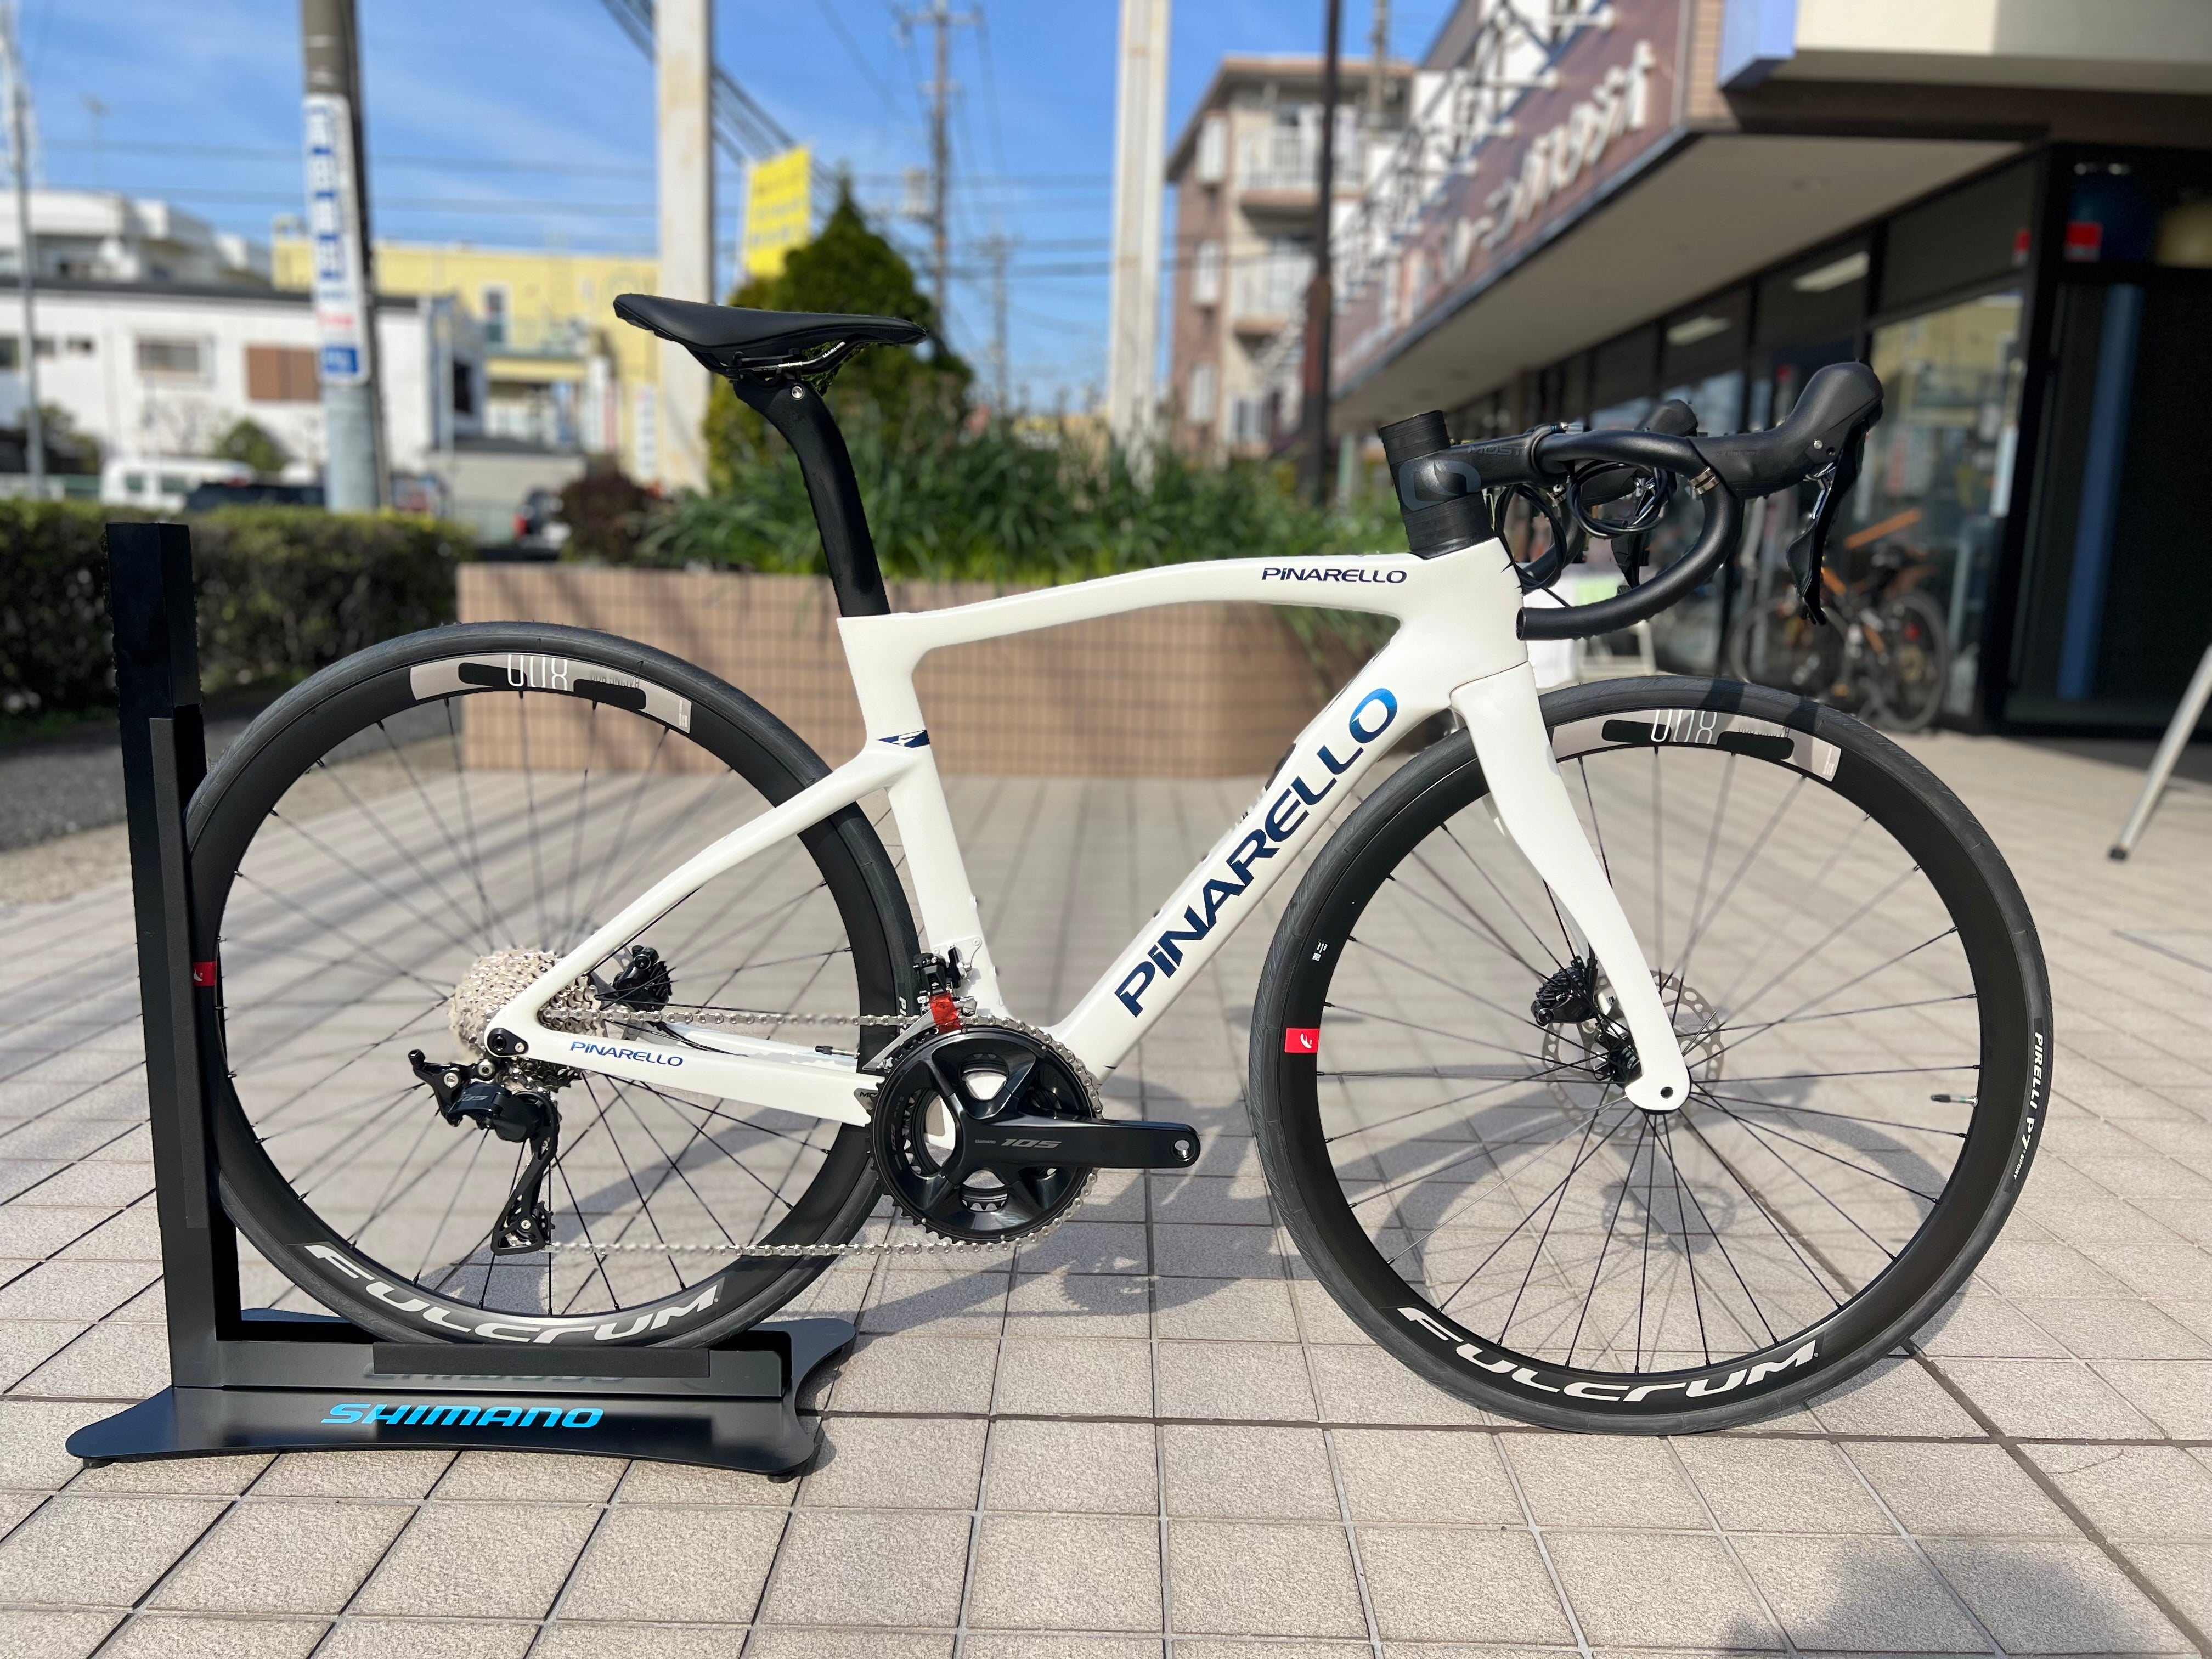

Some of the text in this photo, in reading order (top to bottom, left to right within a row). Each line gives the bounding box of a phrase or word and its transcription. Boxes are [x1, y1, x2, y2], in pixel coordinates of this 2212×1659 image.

[1467, 445, 1523, 456] MOST
[1114, 687, 1398, 1018] PINARELLO
[569, 1041, 684, 1066] PINARELLO
[2030, 1032, 2044, 1110] PIRELLI
[1000, 1138, 1062, 1149] 105
[2013, 1154, 2025, 1180] SPORT
[304, 1244, 719, 1345] FULCRUM
[1397, 1306, 1816, 1403] FULCRUM
[321, 1403, 605, 1429] SHIMANO
